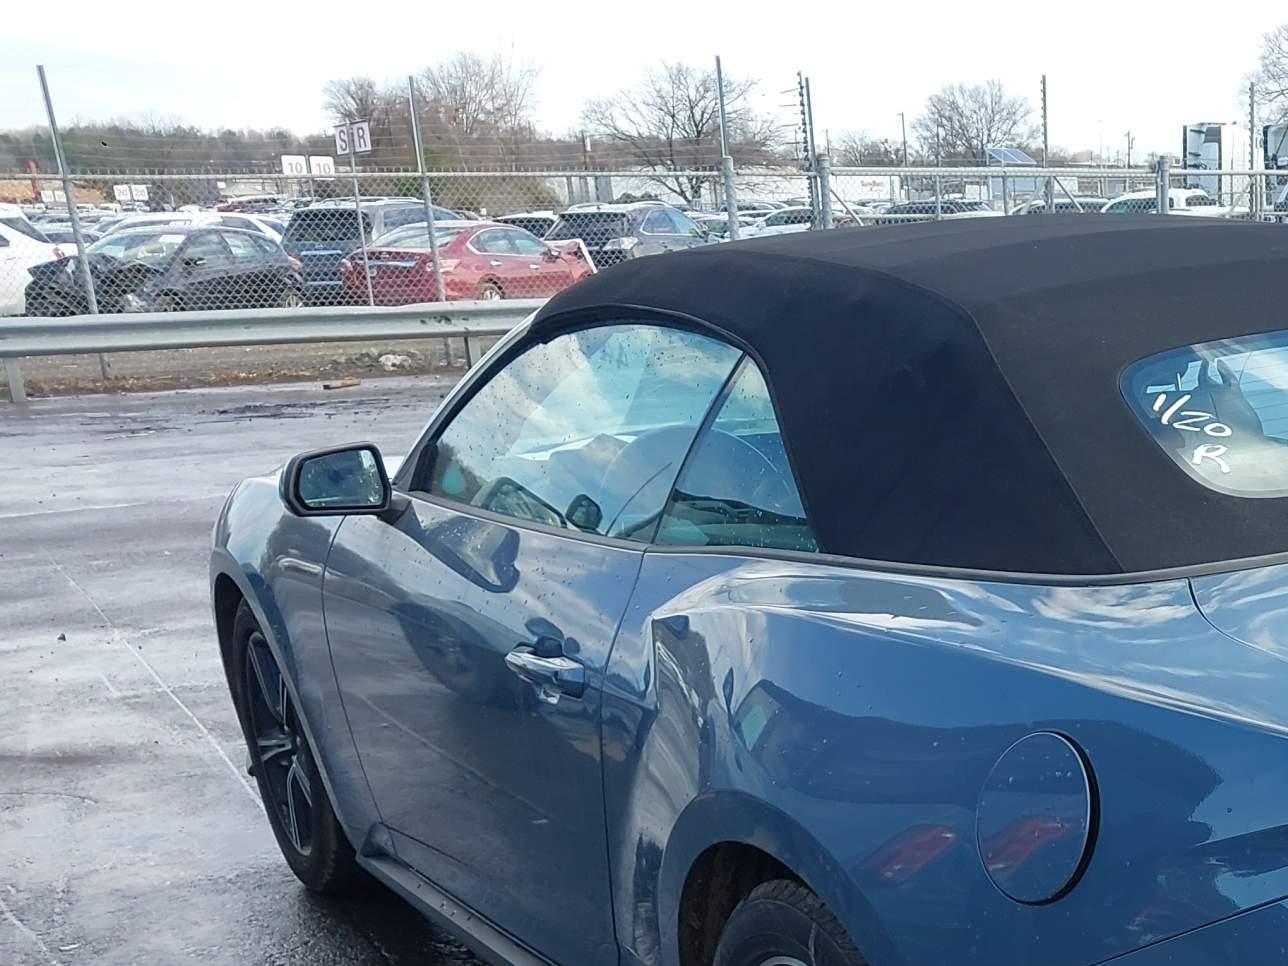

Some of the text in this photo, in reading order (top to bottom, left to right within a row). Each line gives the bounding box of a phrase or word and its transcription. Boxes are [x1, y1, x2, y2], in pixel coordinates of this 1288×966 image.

[338, 129, 348, 152] S
[356, 126, 367, 149] R
[288, 162, 303, 174] 10
[316, 163, 331, 175] 10
[1192, 444, 1230, 473] R
